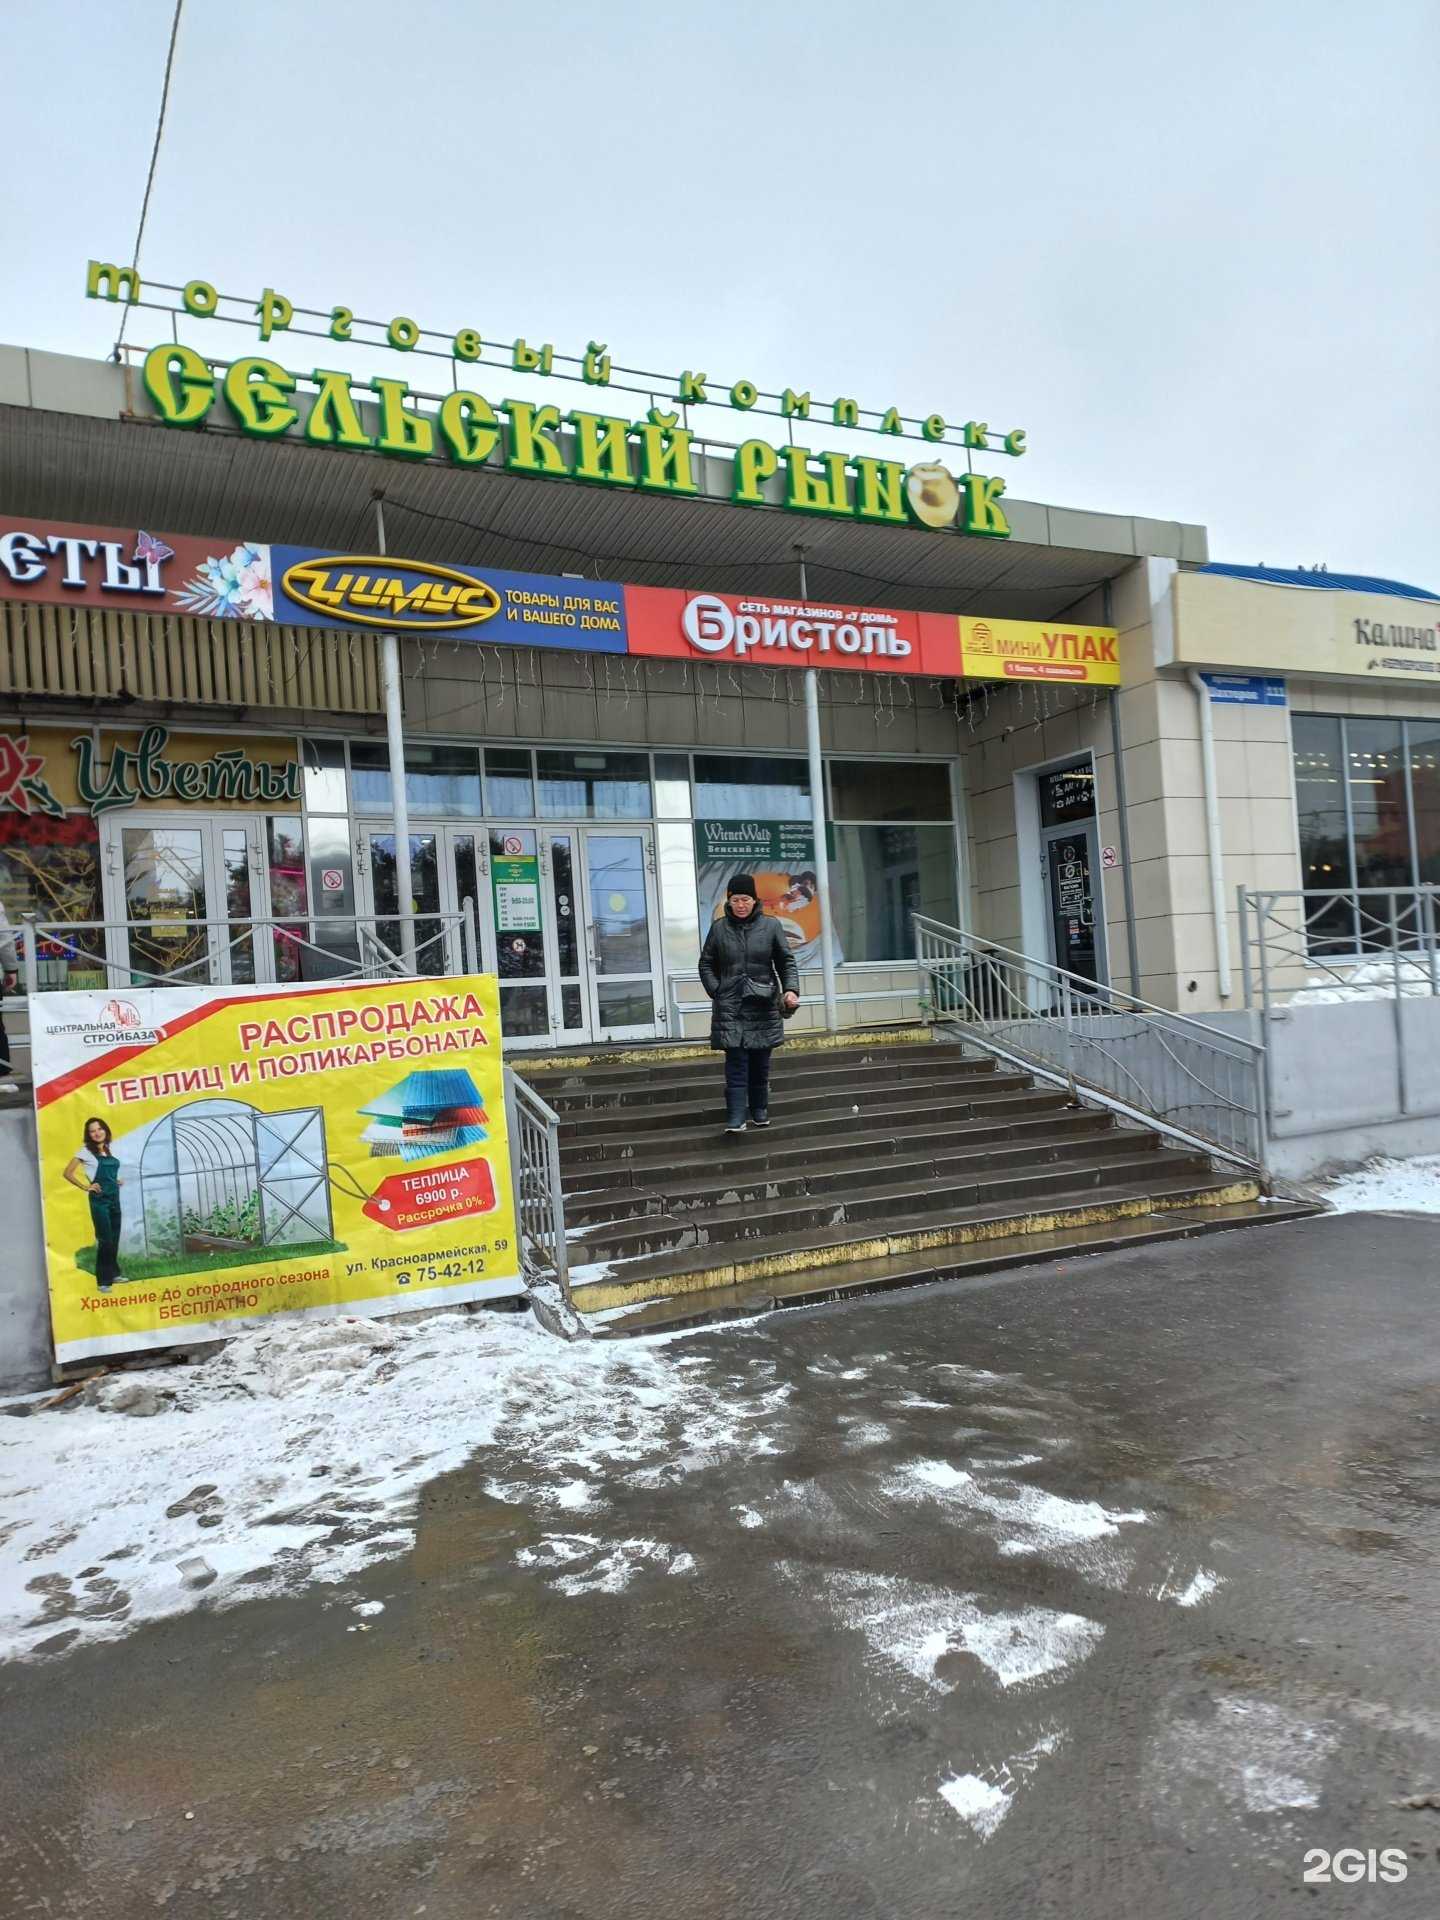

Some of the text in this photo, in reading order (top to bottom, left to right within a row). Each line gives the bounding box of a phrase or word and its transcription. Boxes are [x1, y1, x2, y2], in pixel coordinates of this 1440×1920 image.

[86, 259, 1026, 457] торговый комплекс
[505, 589, 619, 615] ТОВАРЫ ДЛЯ ВАС
[738, 601, 770, 614] СЕТЬ
[771, 605, 844, 621] МАГАЗИНОВ
[507, 607, 621, 633] И ВАШЕГО ДОМА
[683, 594, 912, 656] Бристоль
[1042, 632, 1118, 662] УПАК
[1353, 618, 1437, 652] Калина
[72, 725, 303, 818] Цветы
[46, 1021, 116, 1035] ЦЕНТРАЛЬНАЯ
[240, 994, 484, 1052] РАСПРОДАЖА
[83, 1030, 156, 1044] СТРОЙБАЗА
[101, 1028, 488, 1106] ТЕПЛИЦ И ПОЛИКАРБОНАТА
[402, 1167, 470, 1192] ТЕПЛИЦА
[415, 1188, 463, 1206] 6900 р.
[397, 1203, 464, 1225] Рассрочка
[346, 1239, 508, 1276] ул. Красноармейская, 59
[417, 1258, 484, 1283] 75-42-12
[80, 1267, 330, 1313] Хранение до огородного сезона
[159, 1294, 259, 1320] БЕСПЛАТНО
